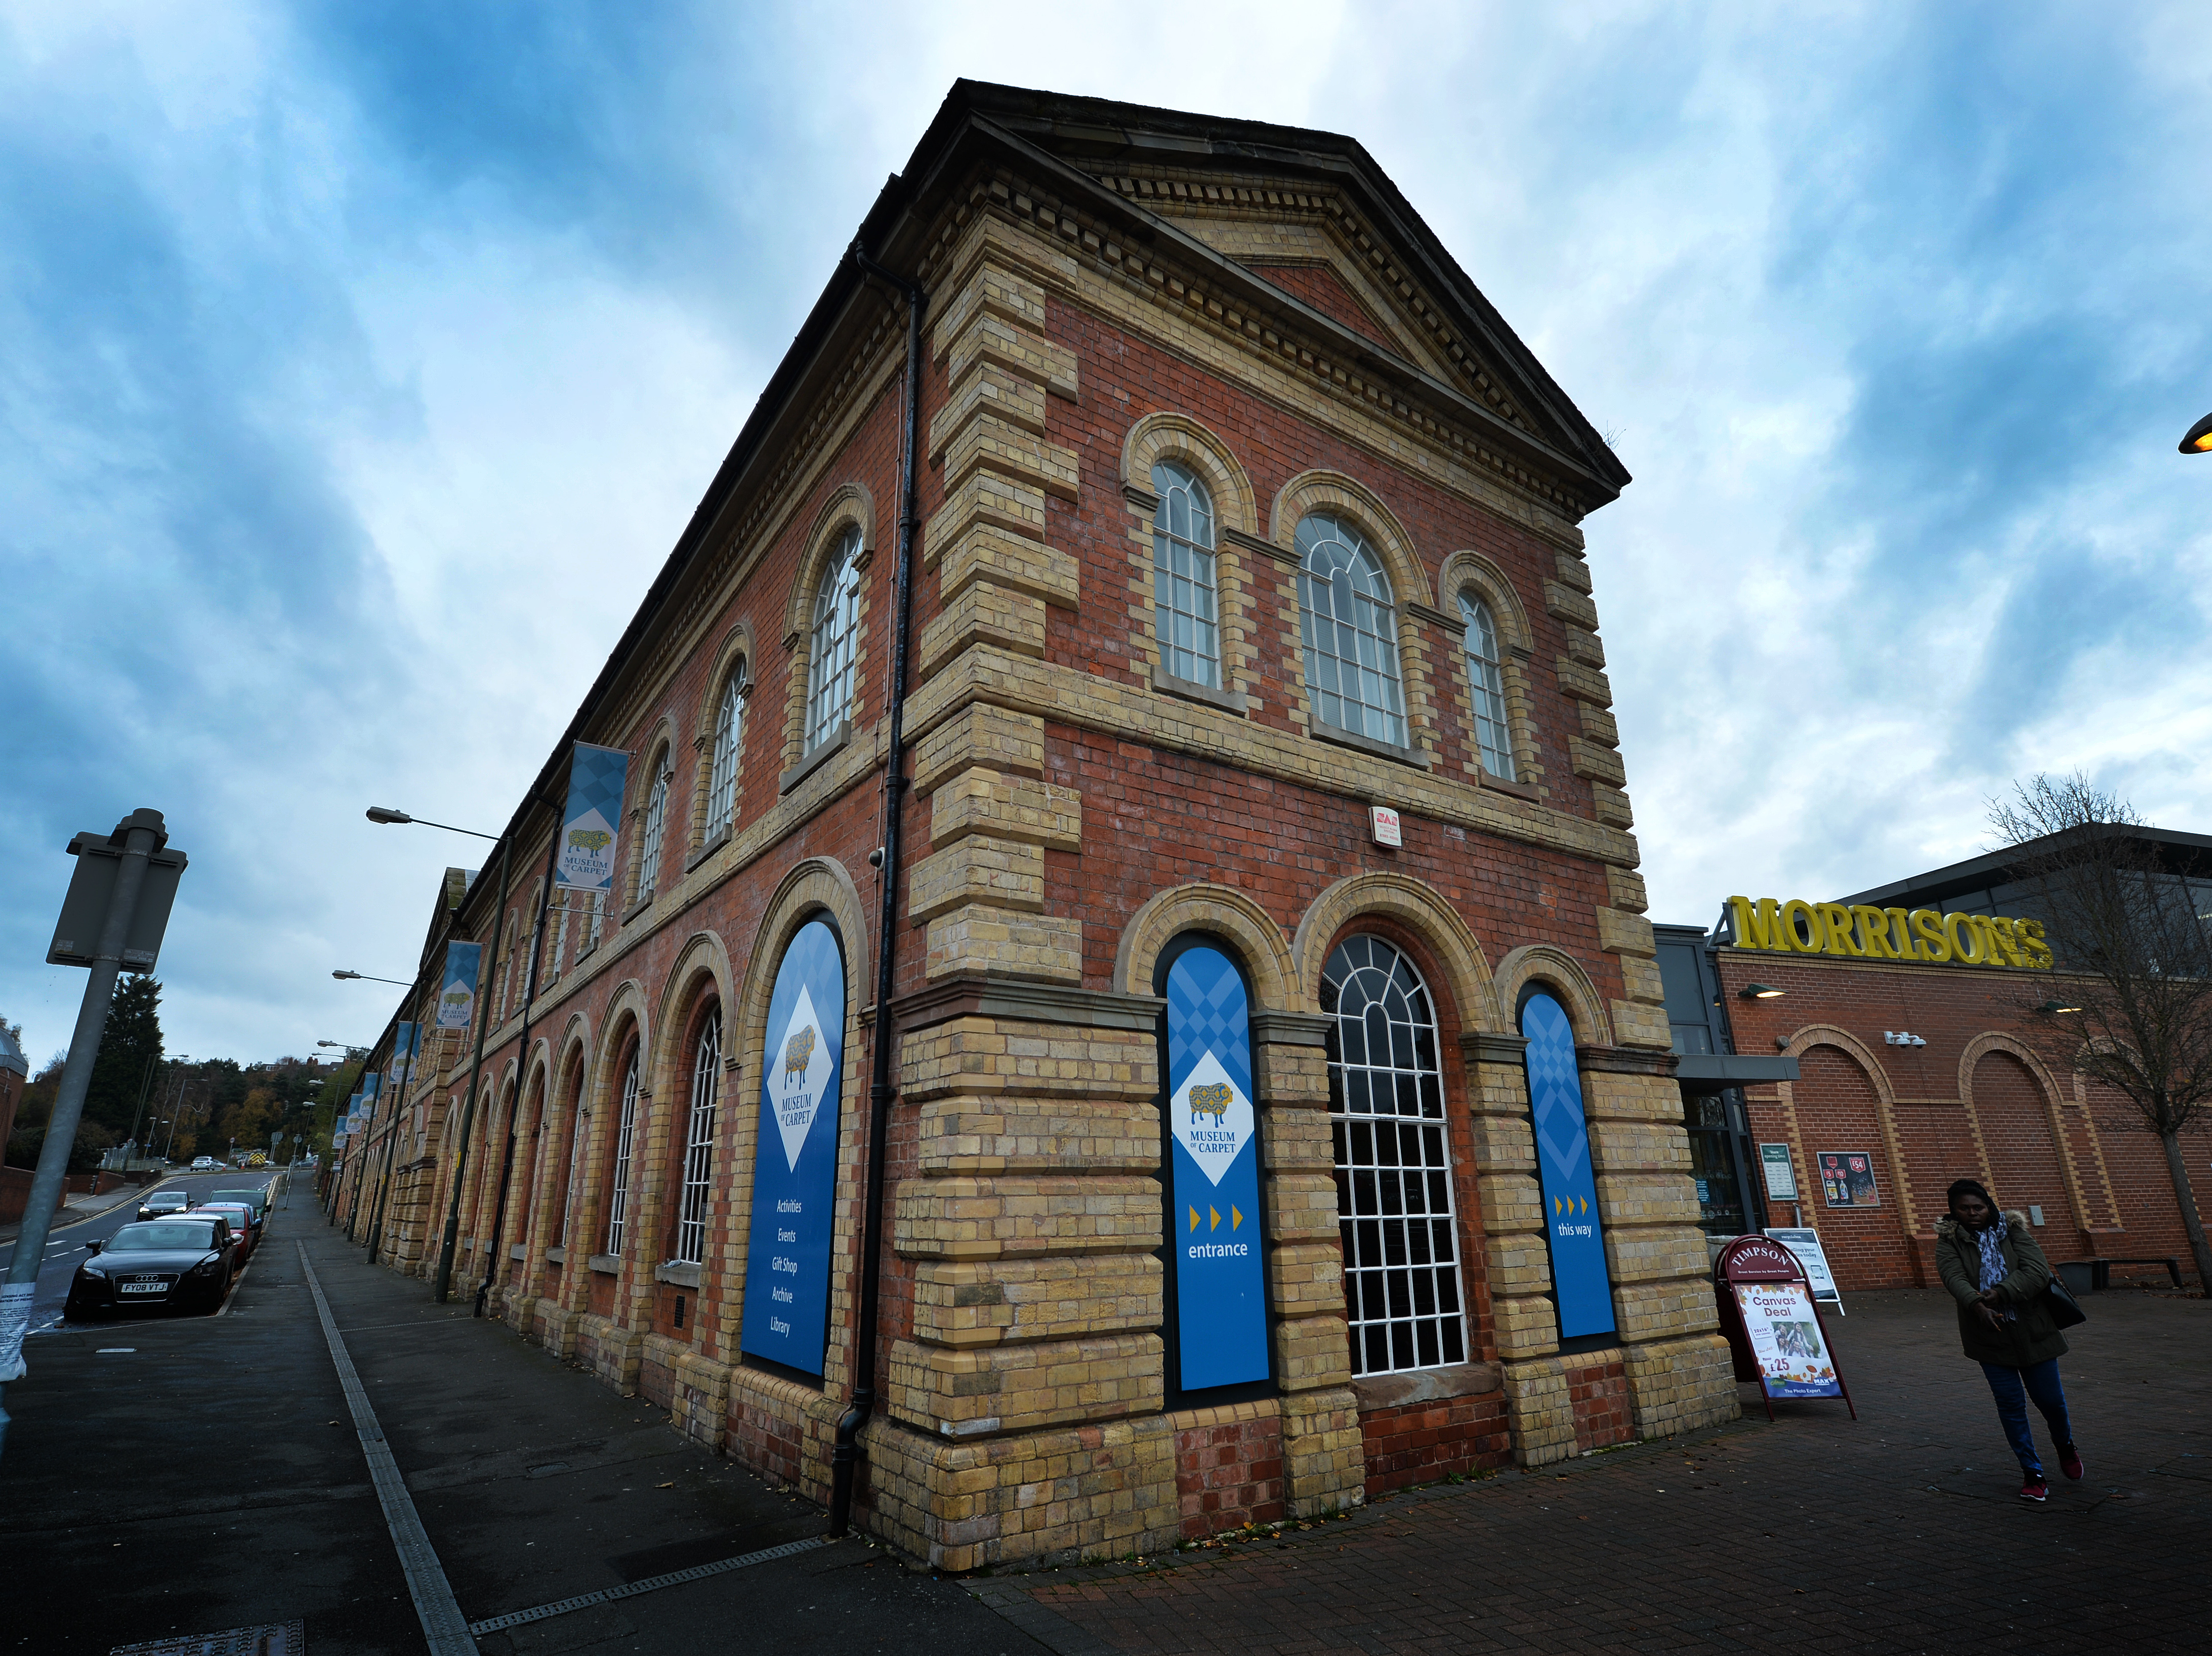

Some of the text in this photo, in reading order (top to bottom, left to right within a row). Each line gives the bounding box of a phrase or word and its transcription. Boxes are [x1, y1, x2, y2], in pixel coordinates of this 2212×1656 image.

[1376, 812, 1398, 826] SAS
[565, 856, 607, 869] MUSEUM
[571, 864, 607, 876] CARPET
[1727, 895, 2054, 969] MORRISONS
[781, 1093, 812, 1112] MUSEUM
[785, 1110, 811, 1127] CARPET
[1190, 1131, 1235, 1142] MUSEUM
[1198, 1143, 1236, 1153] CARPET
[776, 1199, 802, 1213] Activities
[778, 1228, 796, 1243] Events
[1558, 1223, 1592, 1238] this way
[1188, 1243, 1248, 1259] entrance
[1732, 1247, 1789, 1266] TIMPSON
[772, 1256, 798, 1276] Gift Shop
[772, 1286, 793, 1304] Archive
[1753, 1296, 1797, 1306] Canvas
[1764, 1307, 1791, 1316] Deal
[770, 1316, 790, 1338] Library
[1770, 1357, 1790, 1372] £25
